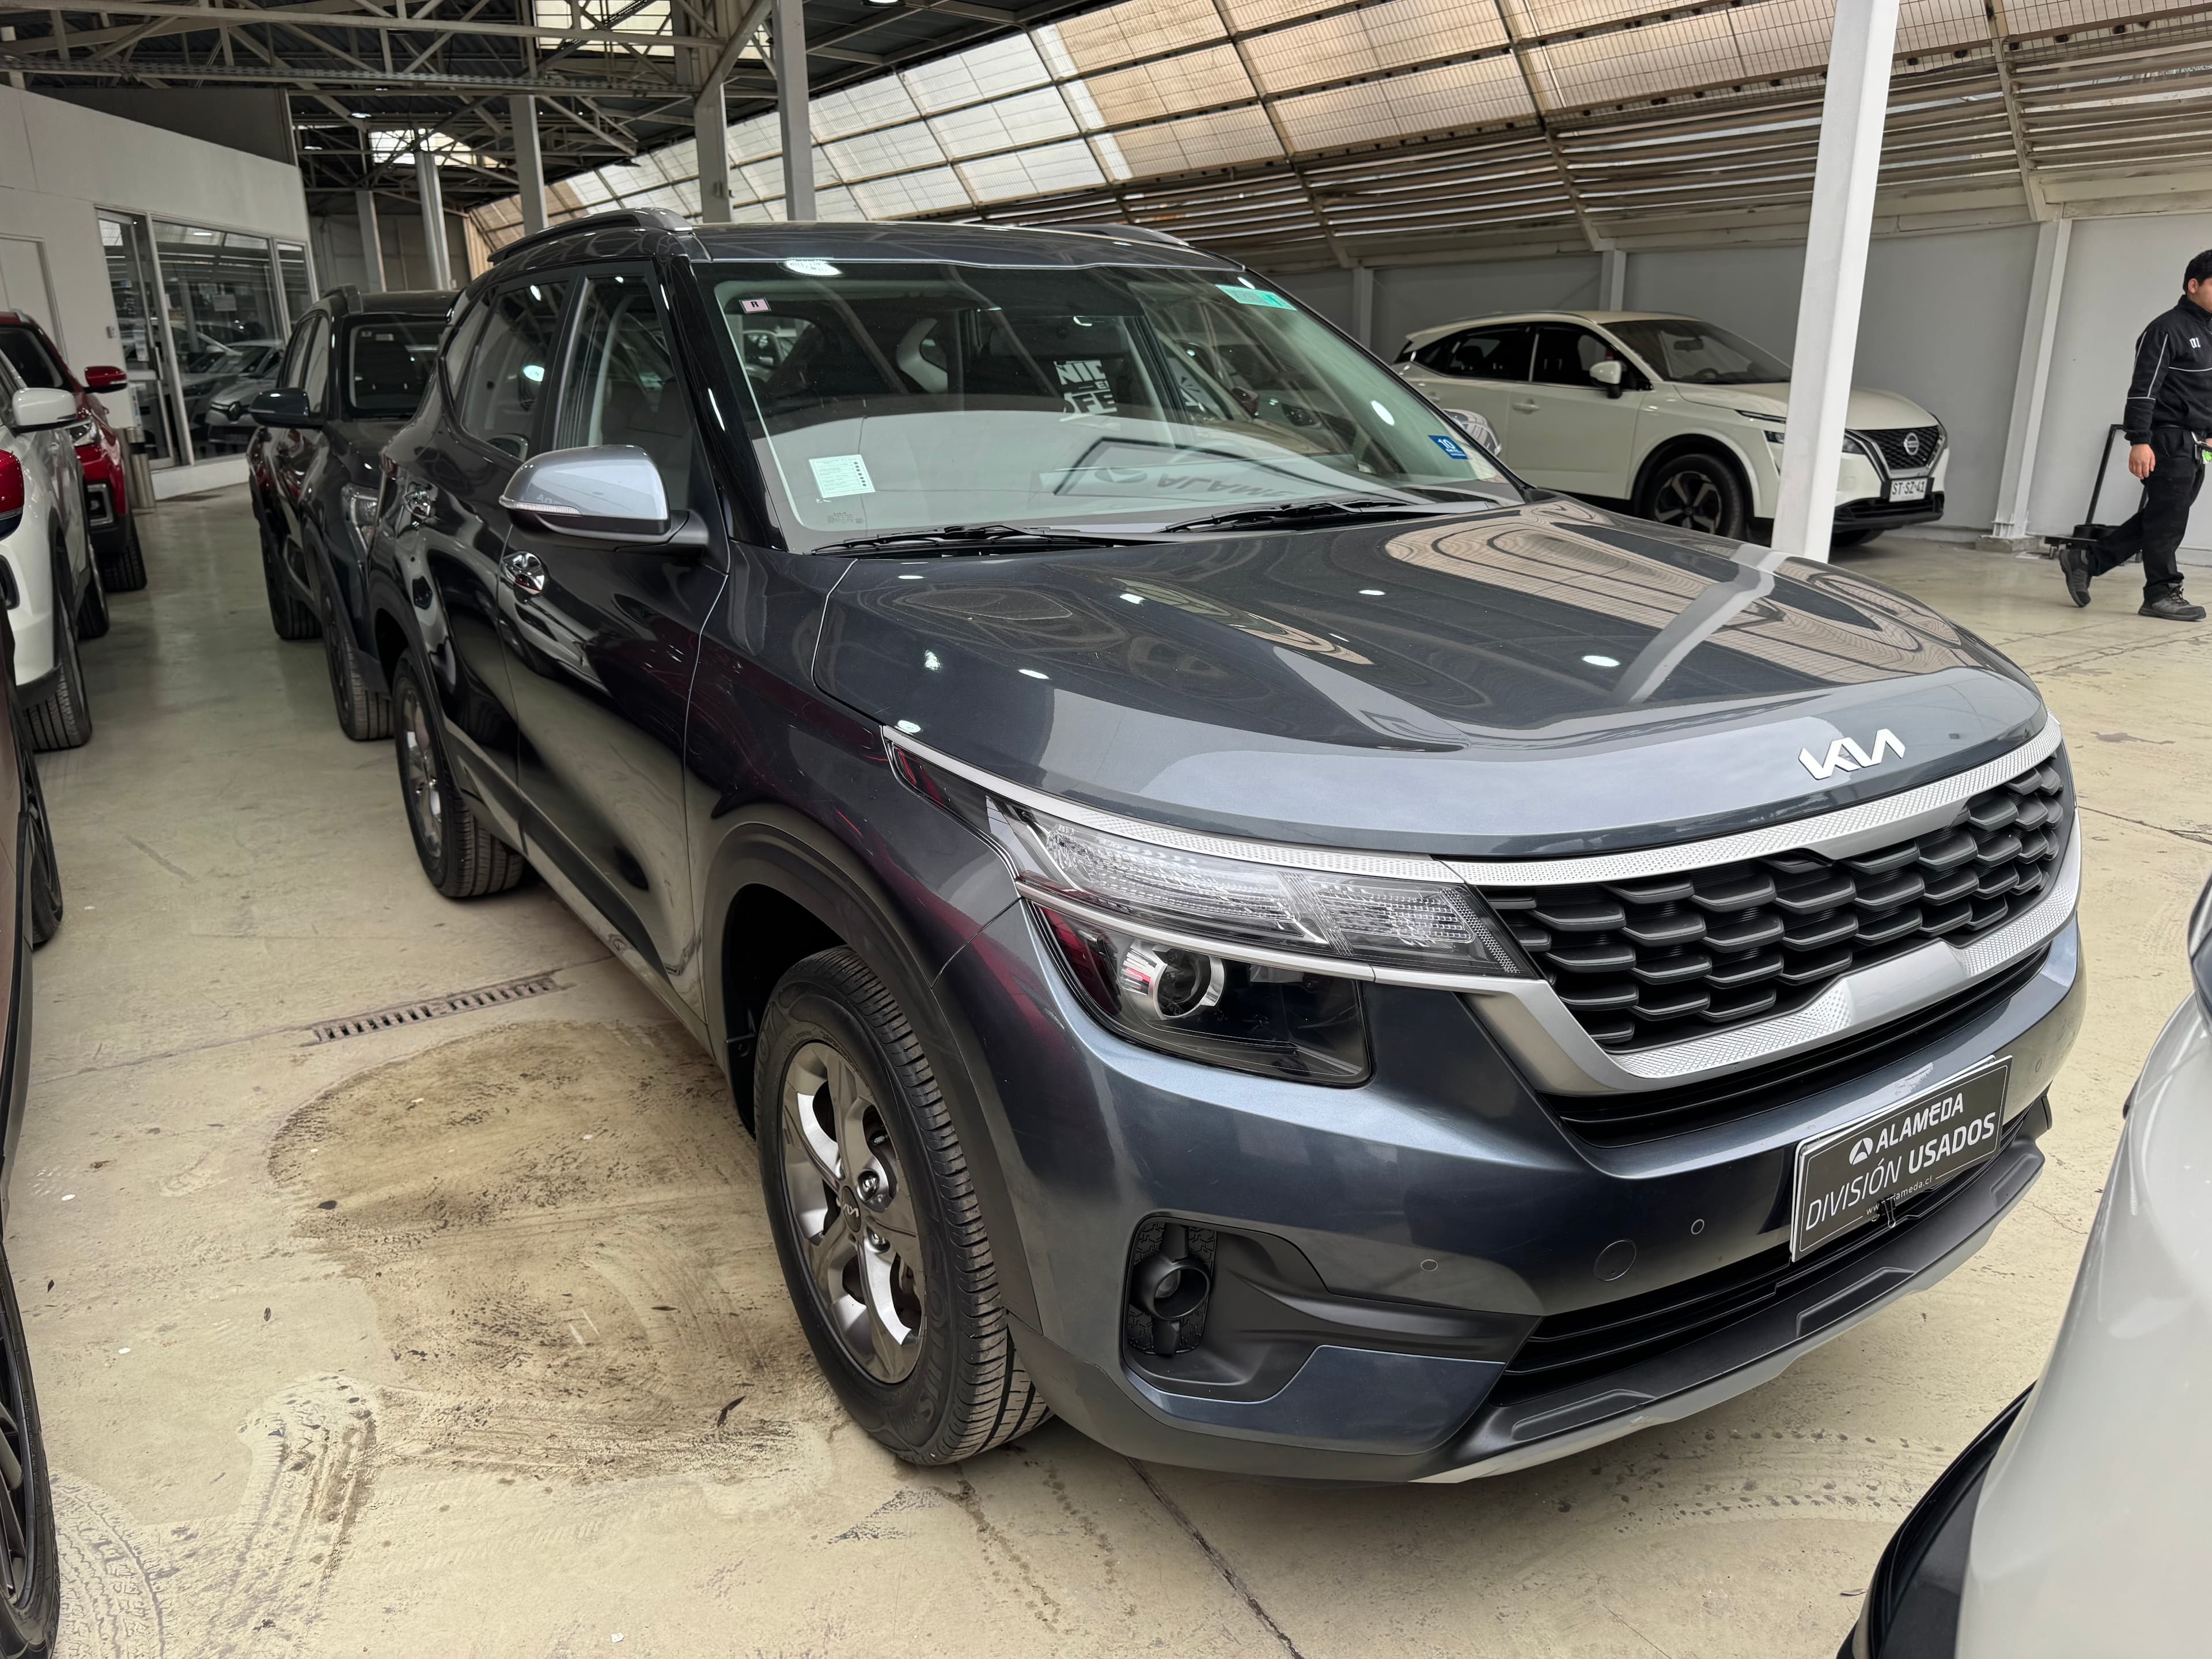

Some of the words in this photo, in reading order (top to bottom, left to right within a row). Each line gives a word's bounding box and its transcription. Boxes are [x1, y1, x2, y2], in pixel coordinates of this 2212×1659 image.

[1437, 438, 1456, 449] 10
[1876, 1093, 1963, 1153] ALAMEDA
[1805, 1156, 1902, 1231] DIVISIÓN
[1908, 1112, 1996, 1174] USADOS
[1866, 1175, 1932, 1215] wwameda.cl
